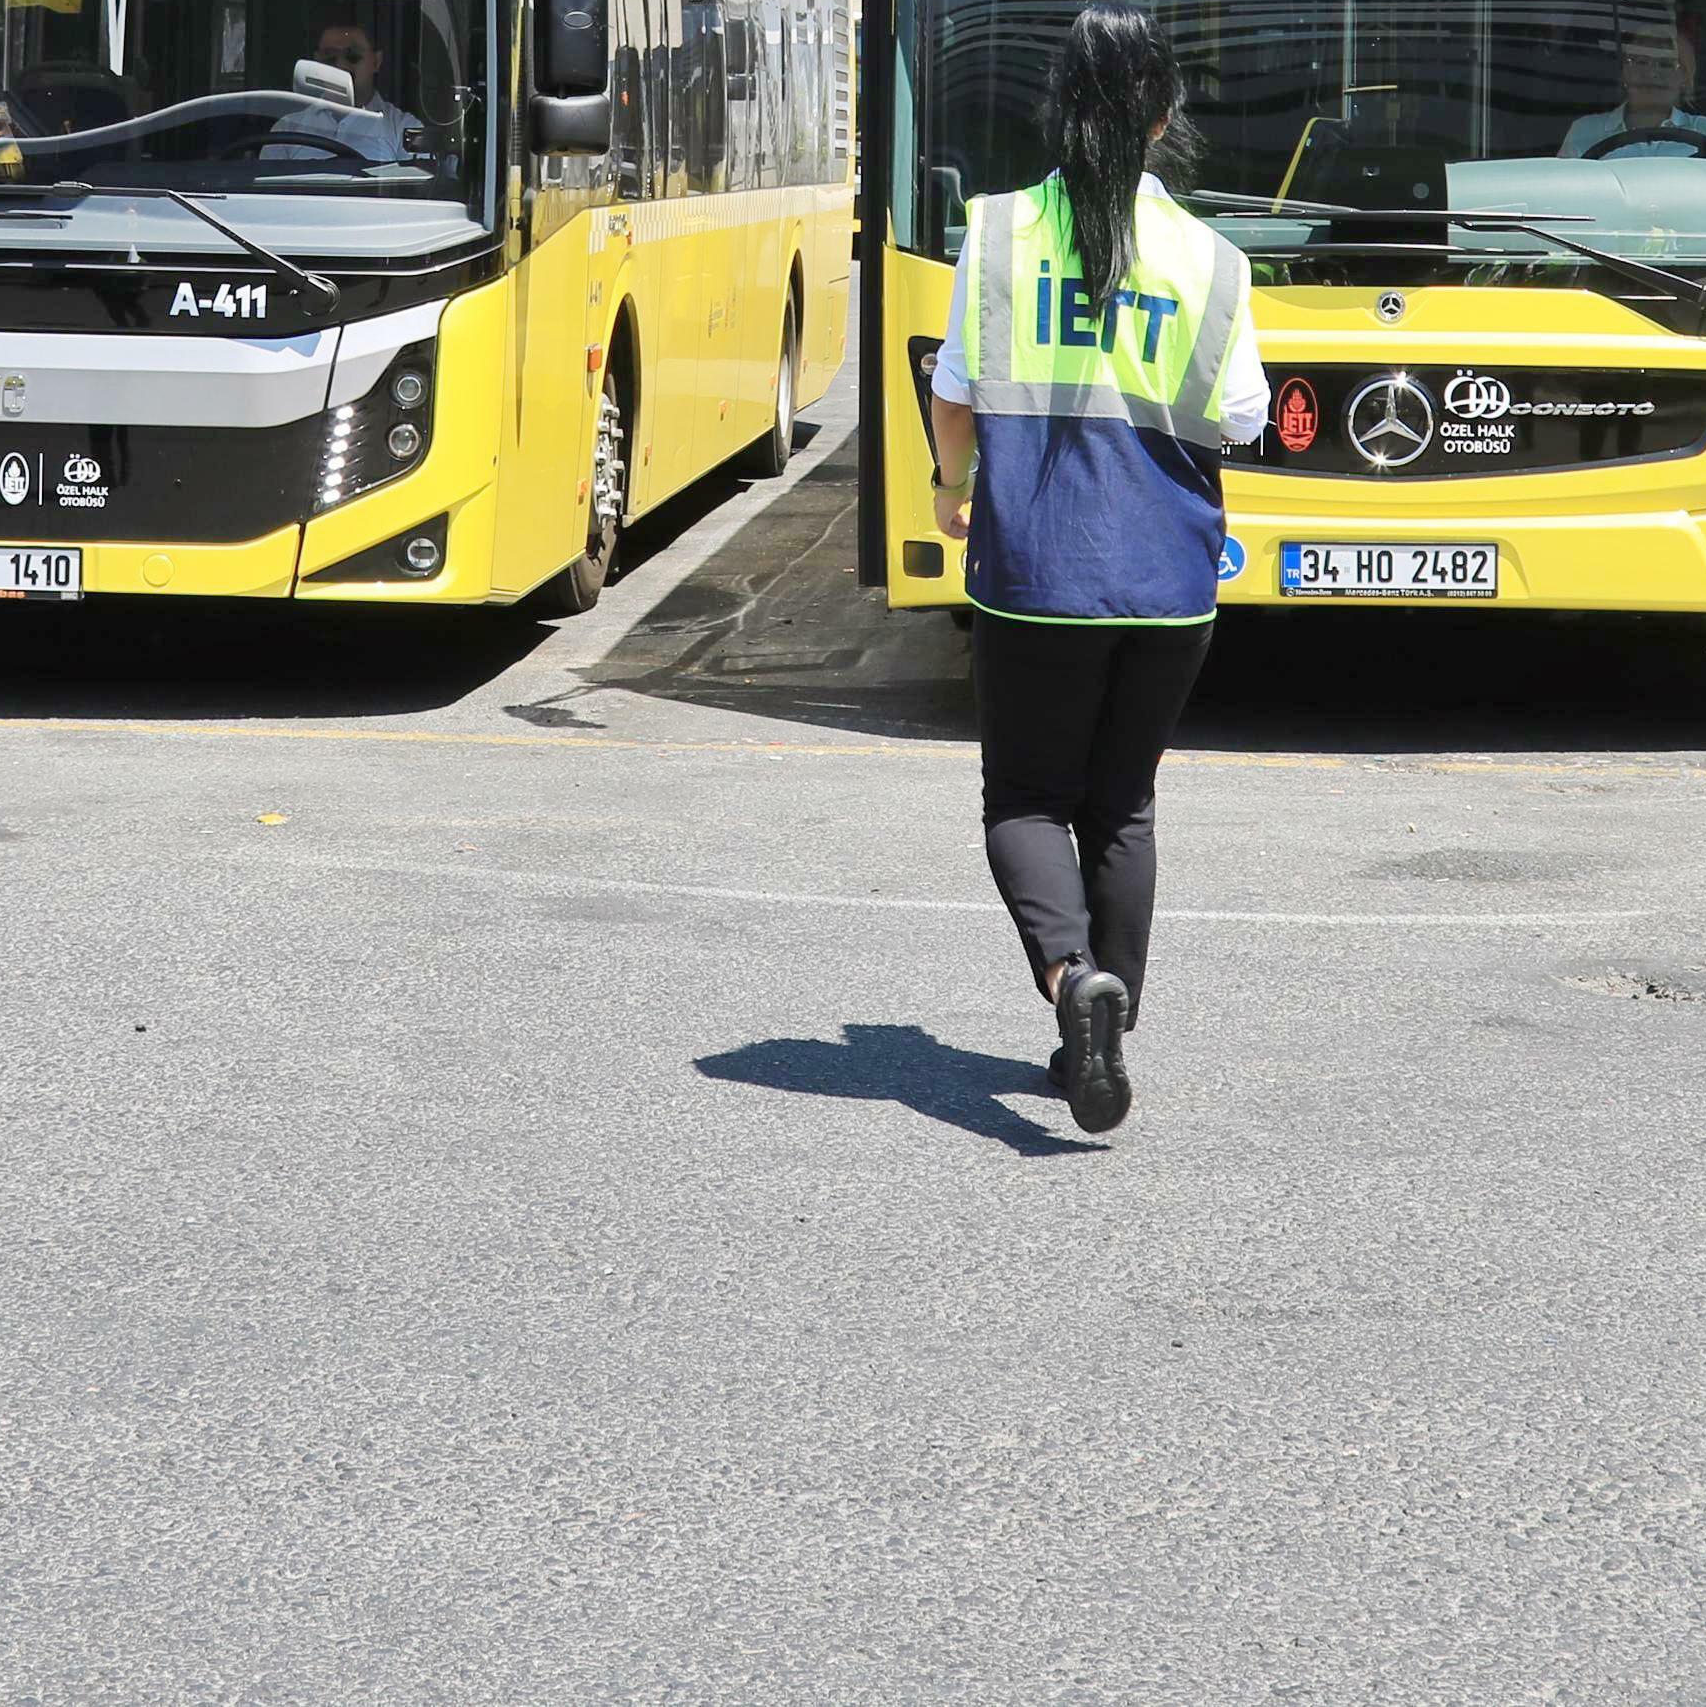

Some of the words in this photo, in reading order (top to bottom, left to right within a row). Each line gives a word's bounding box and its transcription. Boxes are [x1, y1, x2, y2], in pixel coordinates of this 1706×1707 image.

[169, 282, 266, 318] A-411
[1509, 402, 1655, 416] CONECTO
[1440, 422, 1473, 437] ÖZEL
[1477, 424, 1515, 437] HALK
[1444, 438, 1510, 454] OTOBÜSÜ
[56, 483, 80, 496] ÖZEL
[82, 486, 108, 496] HALK
[10, 553, 70, 586] 1410
[1286, 568, 1300, 578] TR
[1303, 549, 1339, 583] 34
[1356, 550, 1393, 583] HO
[1412, 550, 1488, 583] 2482
